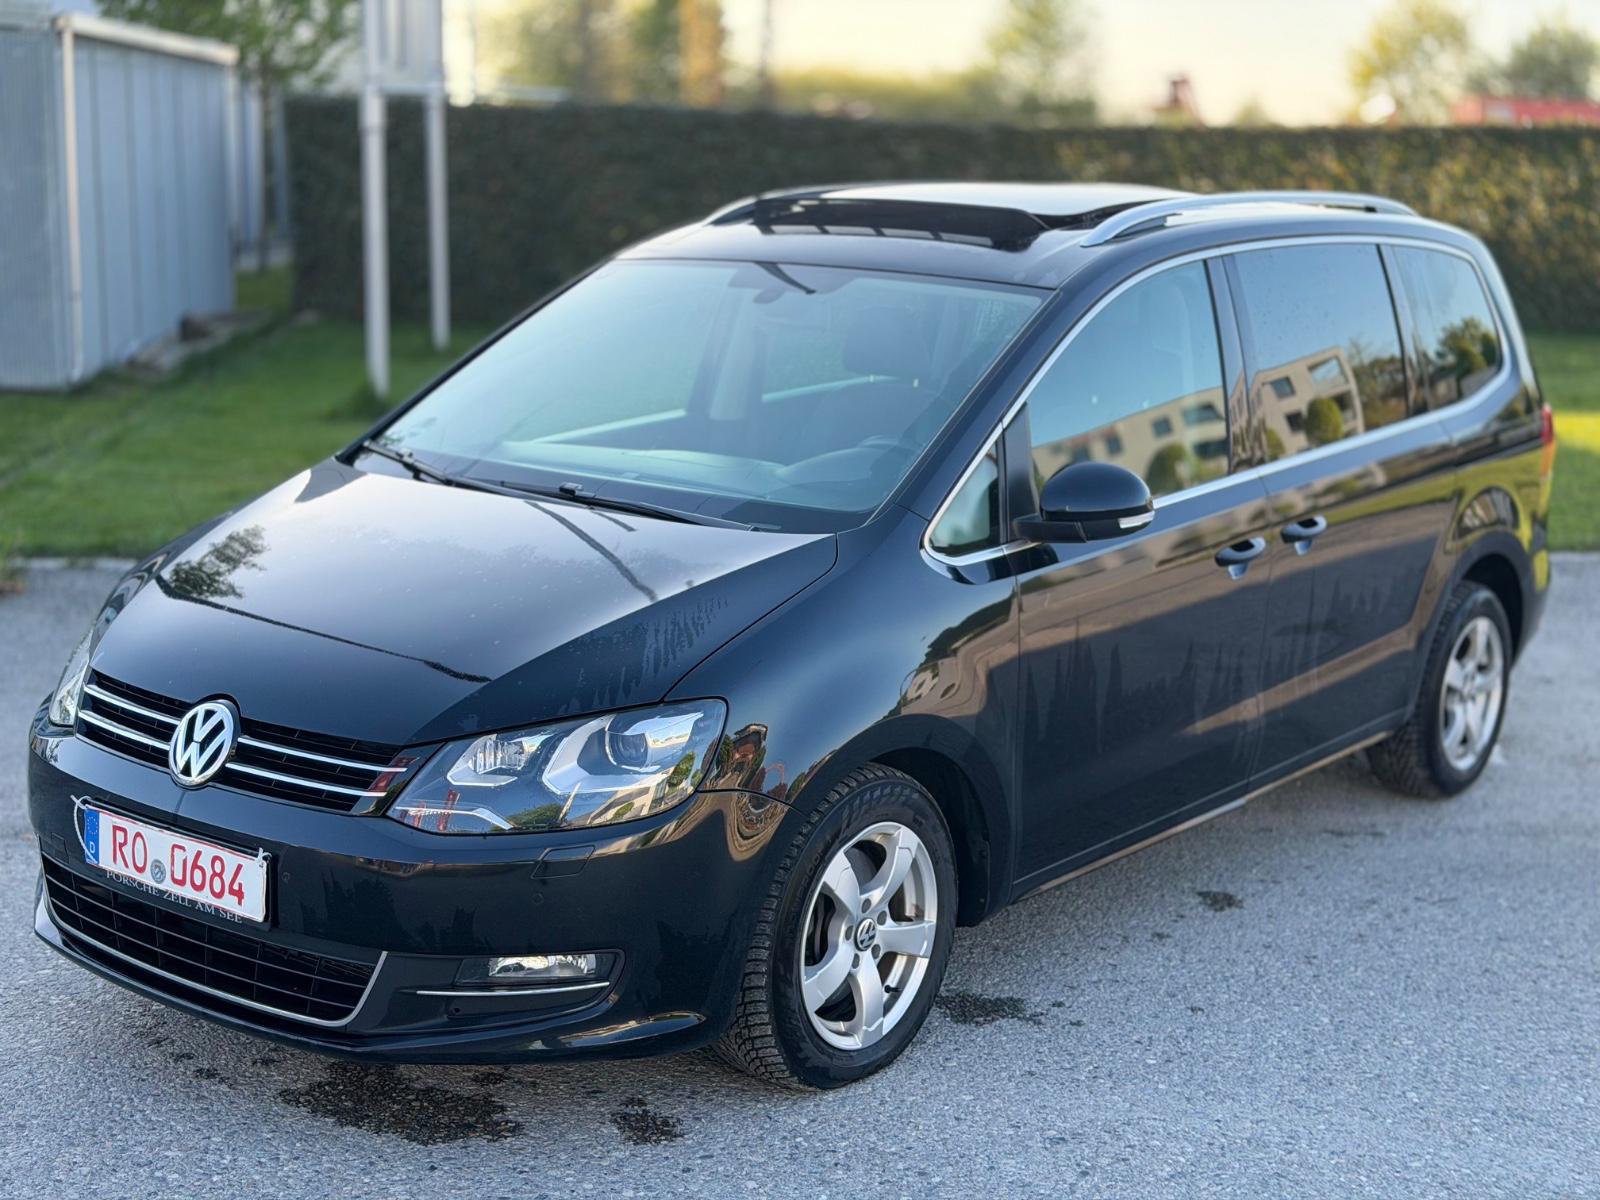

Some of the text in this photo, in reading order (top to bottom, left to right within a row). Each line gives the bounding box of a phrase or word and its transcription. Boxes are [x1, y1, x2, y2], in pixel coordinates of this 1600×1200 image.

[171, 702, 231, 783] VW
[89, 841, 96, 854] D
[112, 825, 148, 873] RO
[106, 870, 243, 923] PORSCHE ZELL AM SEE
